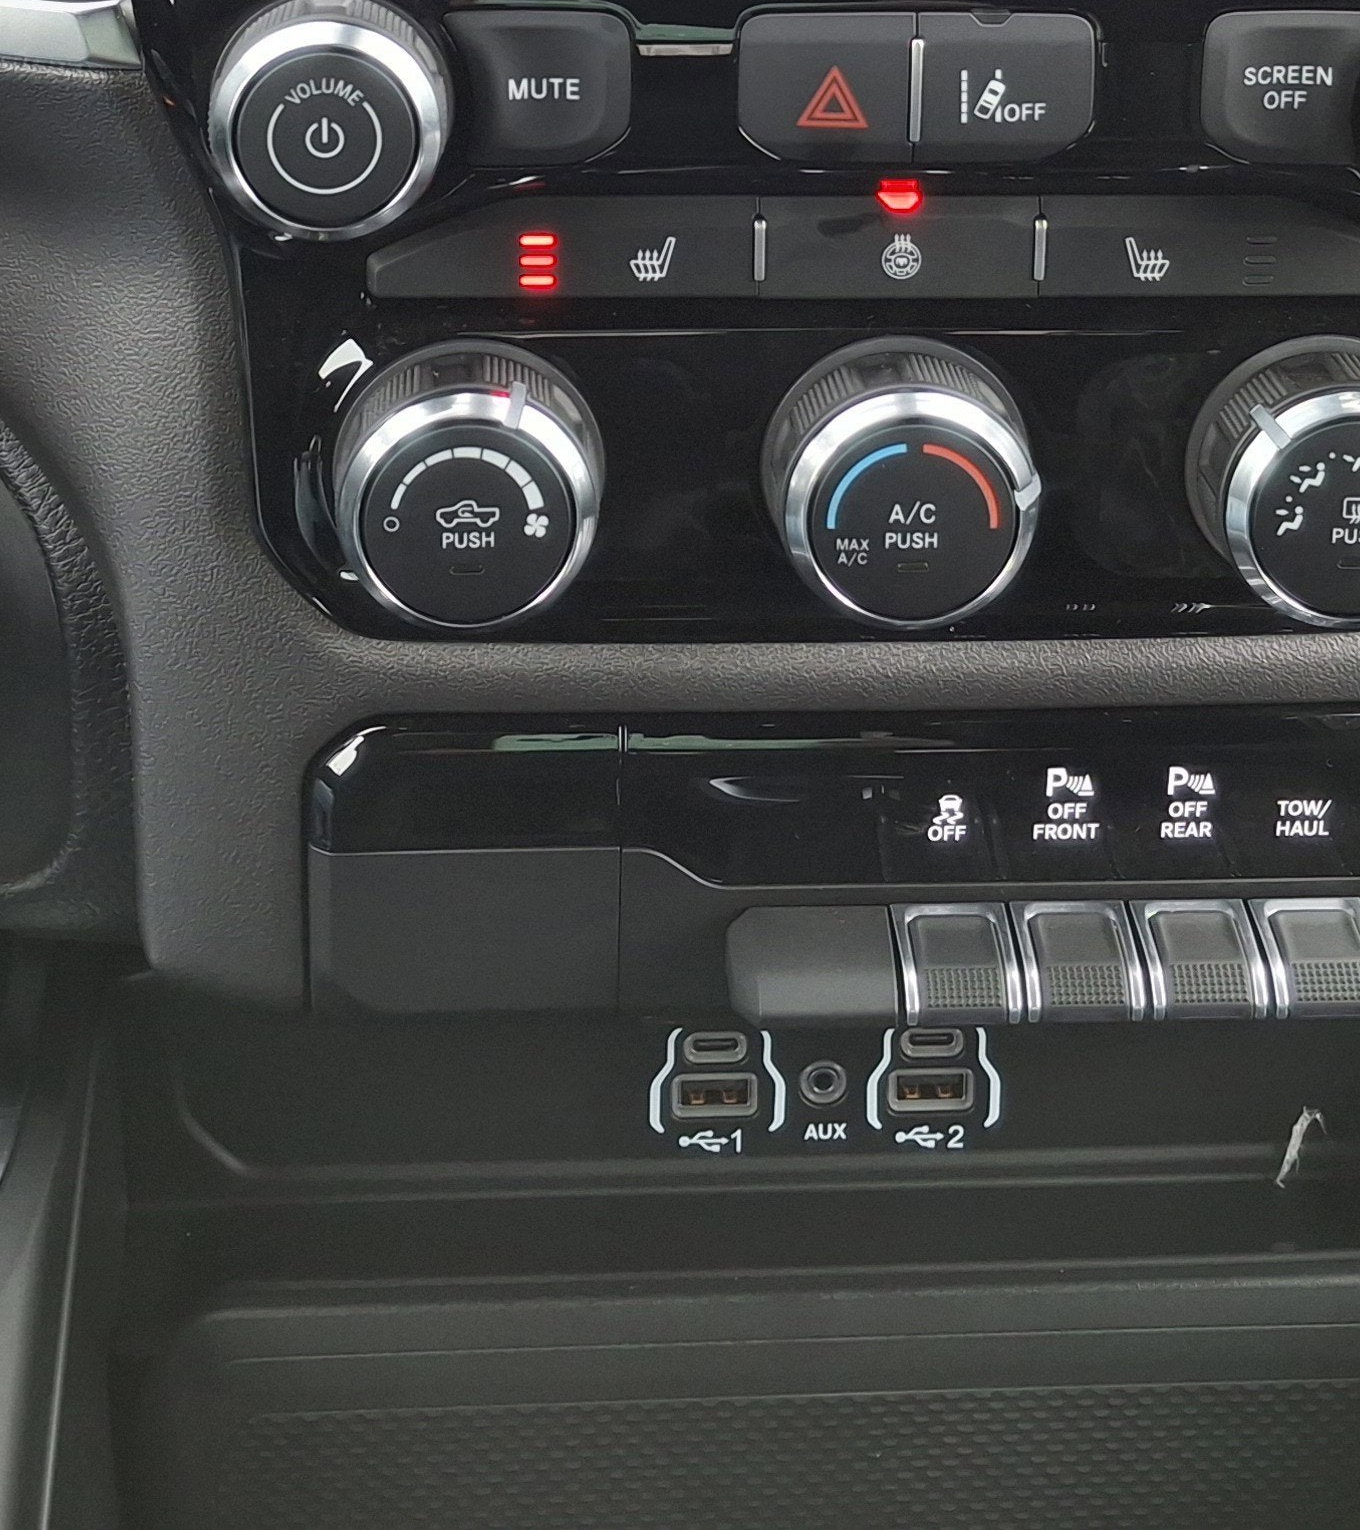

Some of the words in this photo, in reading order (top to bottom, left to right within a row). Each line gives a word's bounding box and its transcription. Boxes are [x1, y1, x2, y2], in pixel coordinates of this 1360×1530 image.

[1243, 67, 1333, 86] SCREEN
[285, 78, 365, 107] VOLUME
[508, 78, 580, 100] MUTE
[1263, 91, 1307, 110] OFF
[1004, 103, 1046, 123] OFF
[889, 501, 936, 526] A/C
[441, 531, 495, 549] PUSH
[836, 538, 869, 551] MAX
[884, 532, 938, 549] PUSH
[837, 551, 868, 565] A/C
[1048, 803, 1087, 819] OFF
[1169, 801, 1208, 818] OFF
[1278, 799, 1331, 817] TOW/
[928, 825, 967, 842] OFF
[1033, 823, 1099, 841] FRONT
[1161, 822, 1212, 839] REAR
[1275, 820, 1329, 837] HAUL
[804, 1123, 847, 1140] AUX
[948, 1126, 964, 1148] 2
[731, 1130, 742, 1153] 1
